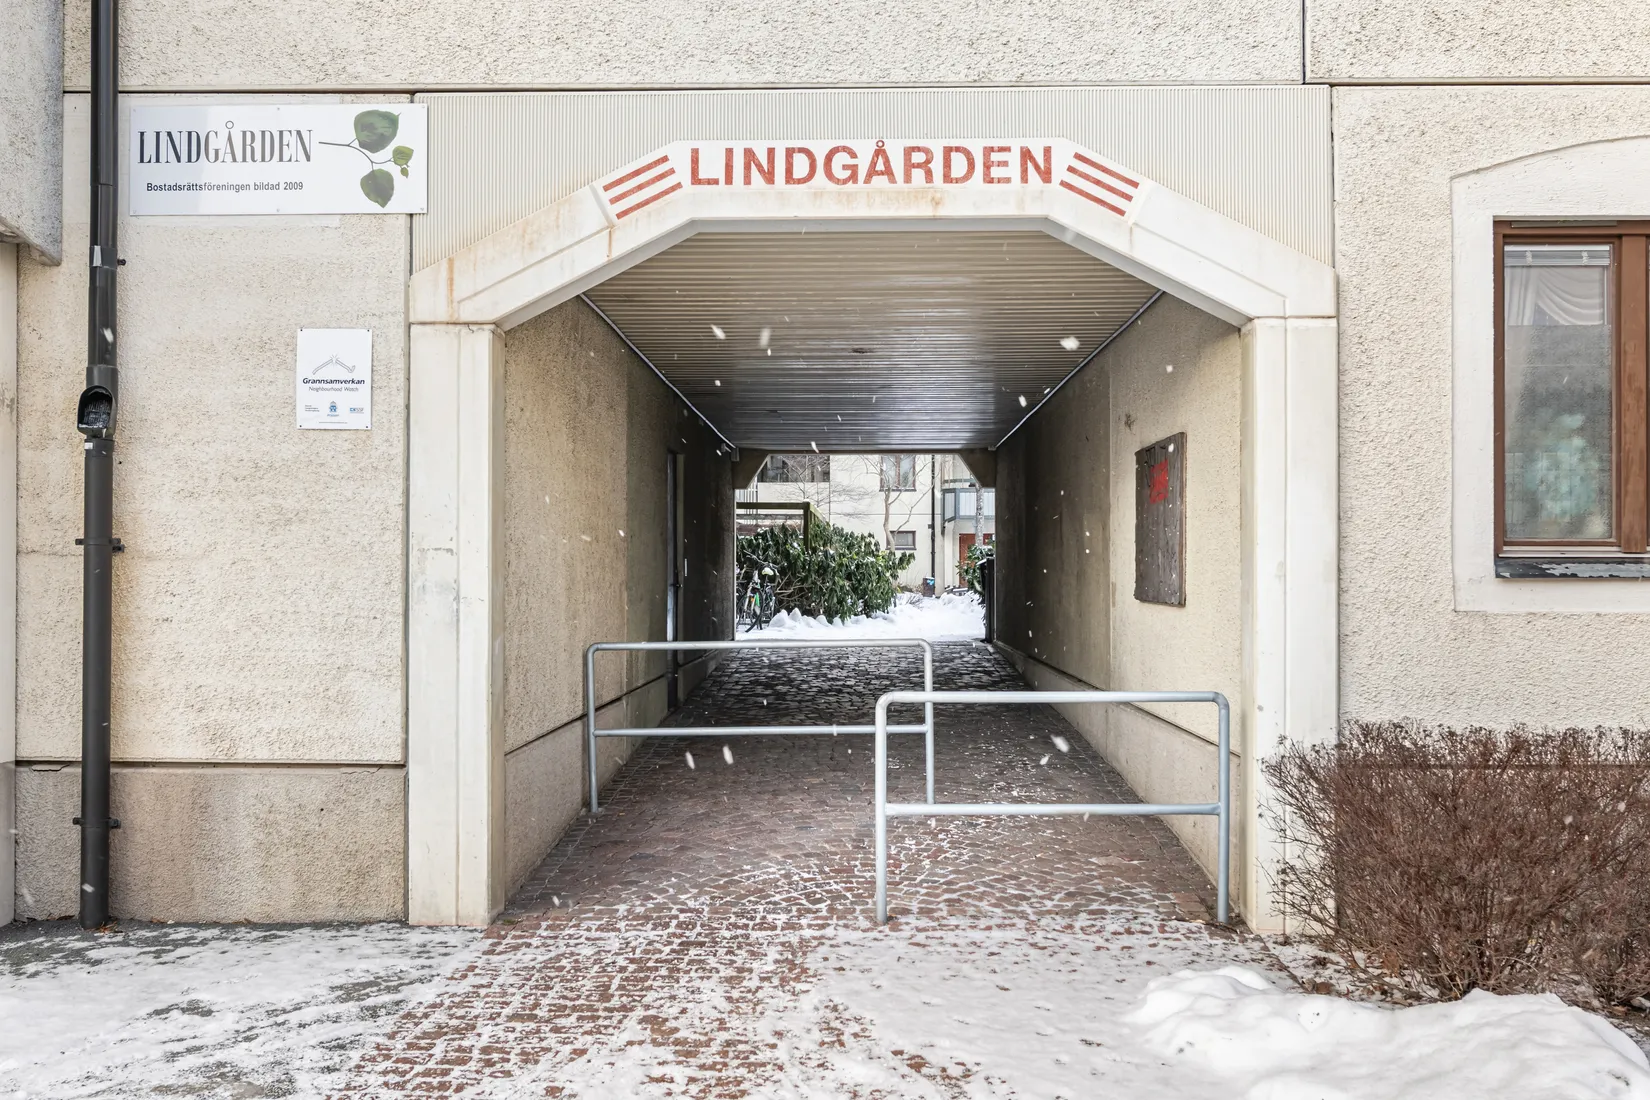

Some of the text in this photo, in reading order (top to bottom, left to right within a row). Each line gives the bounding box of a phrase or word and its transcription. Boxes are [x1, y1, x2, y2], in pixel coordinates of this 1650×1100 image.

[137, 120, 313, 164] LINDGÅRDEN
[690, 139, 1053, 186] LINDGÅRDEN
[146, 181, 304, 194] Bostadsrättsföreningen bildad 2009
[302, 377, 365, 385] Grannsamverkan
